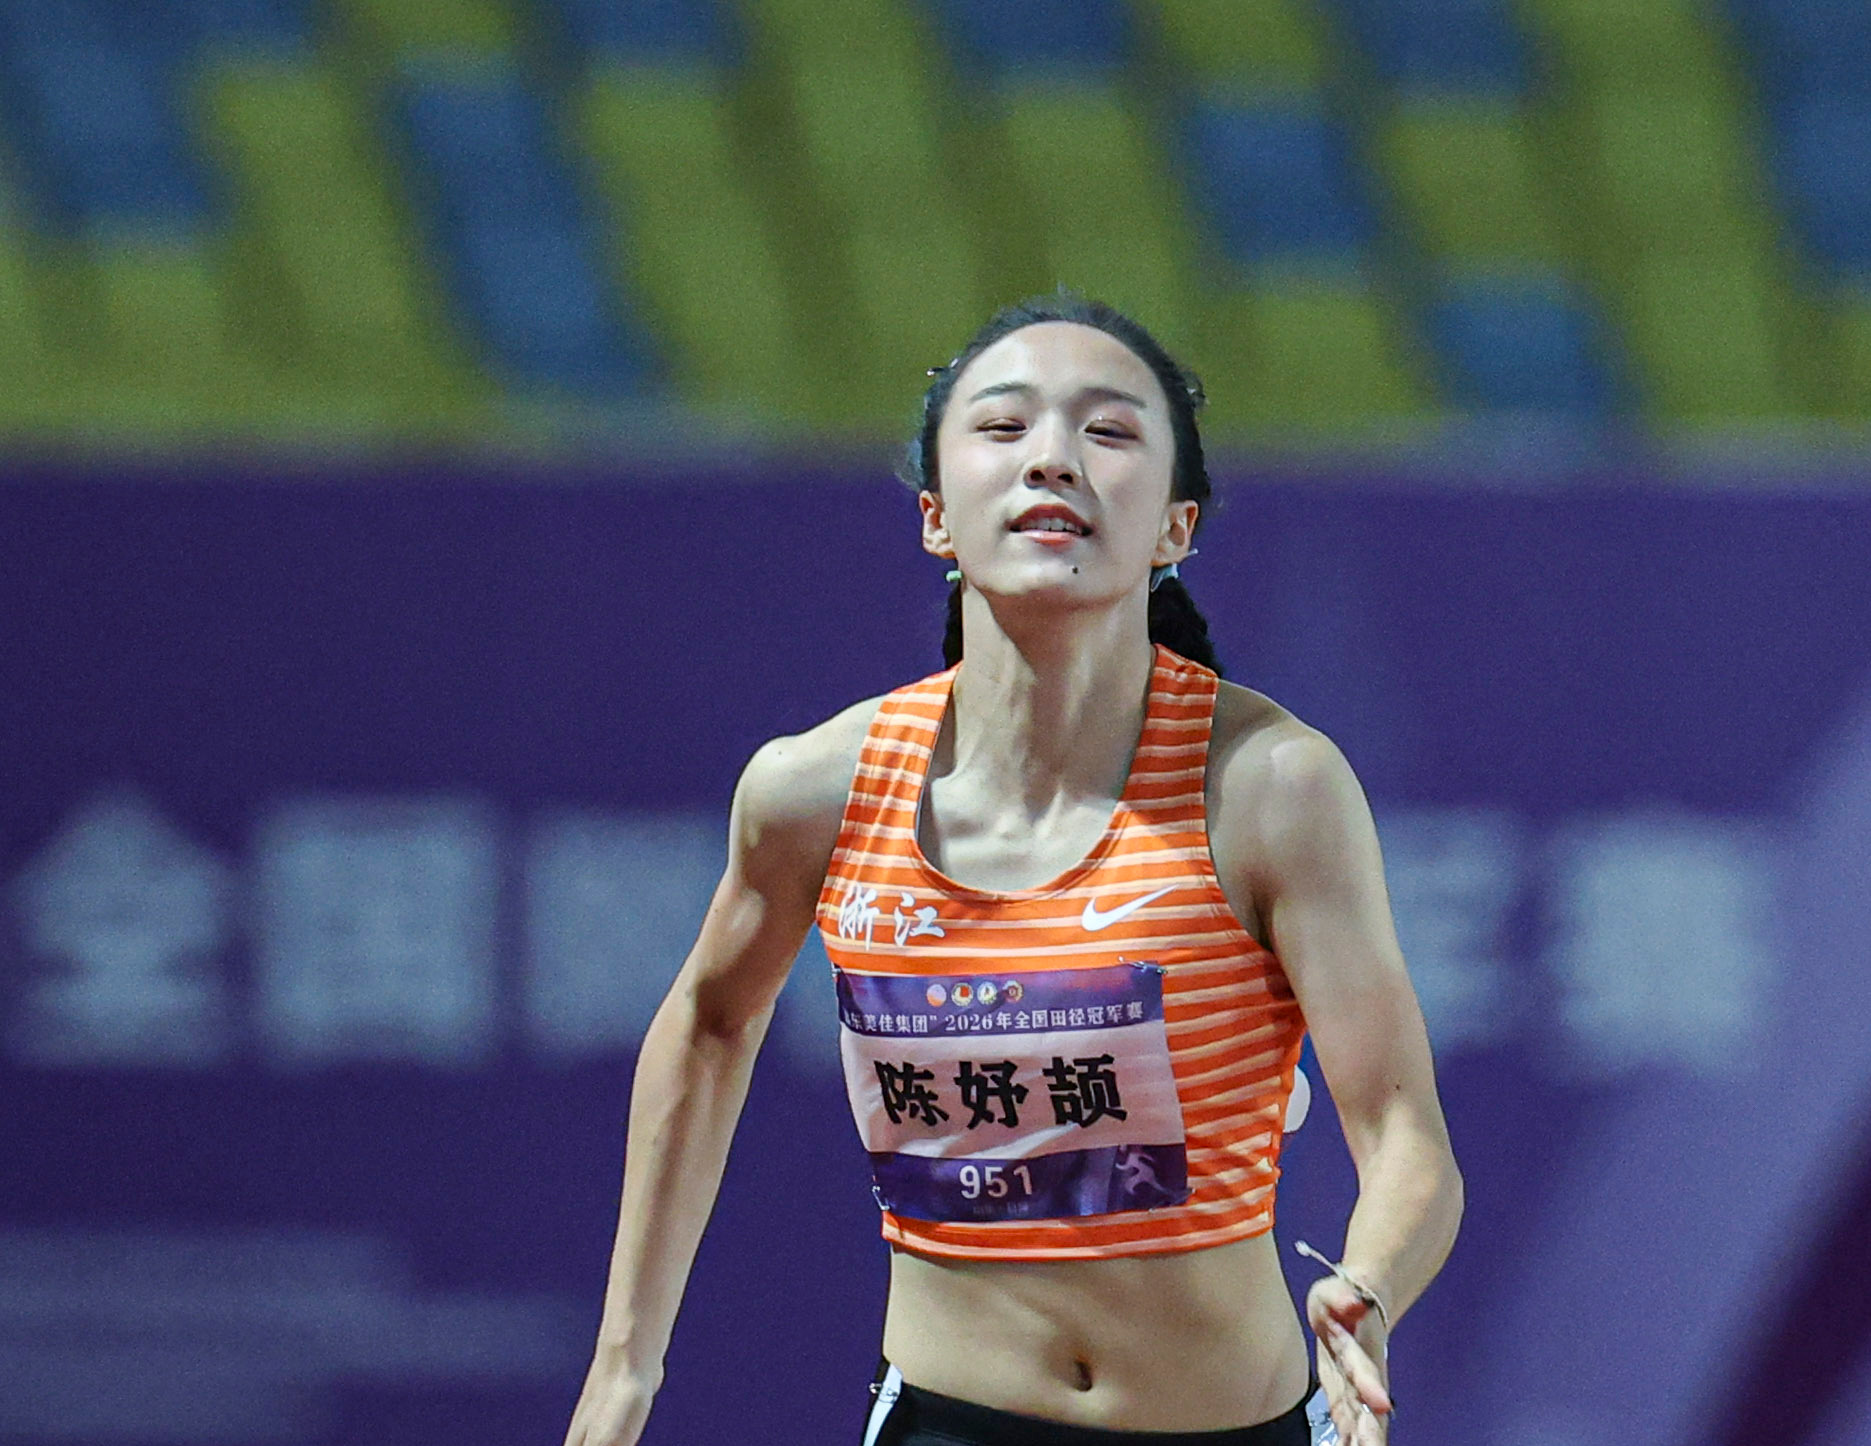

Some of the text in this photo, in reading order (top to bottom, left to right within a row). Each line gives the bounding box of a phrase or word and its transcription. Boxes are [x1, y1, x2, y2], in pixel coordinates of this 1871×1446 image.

[838, 881, 946, 952] 浙江
[945, 1001, 1144, 1032] 2026年全国田径冠军赛
[873, 1053, 1128, 1130] 陈妤颉
[959, 1164, 1034, 1200] 951
